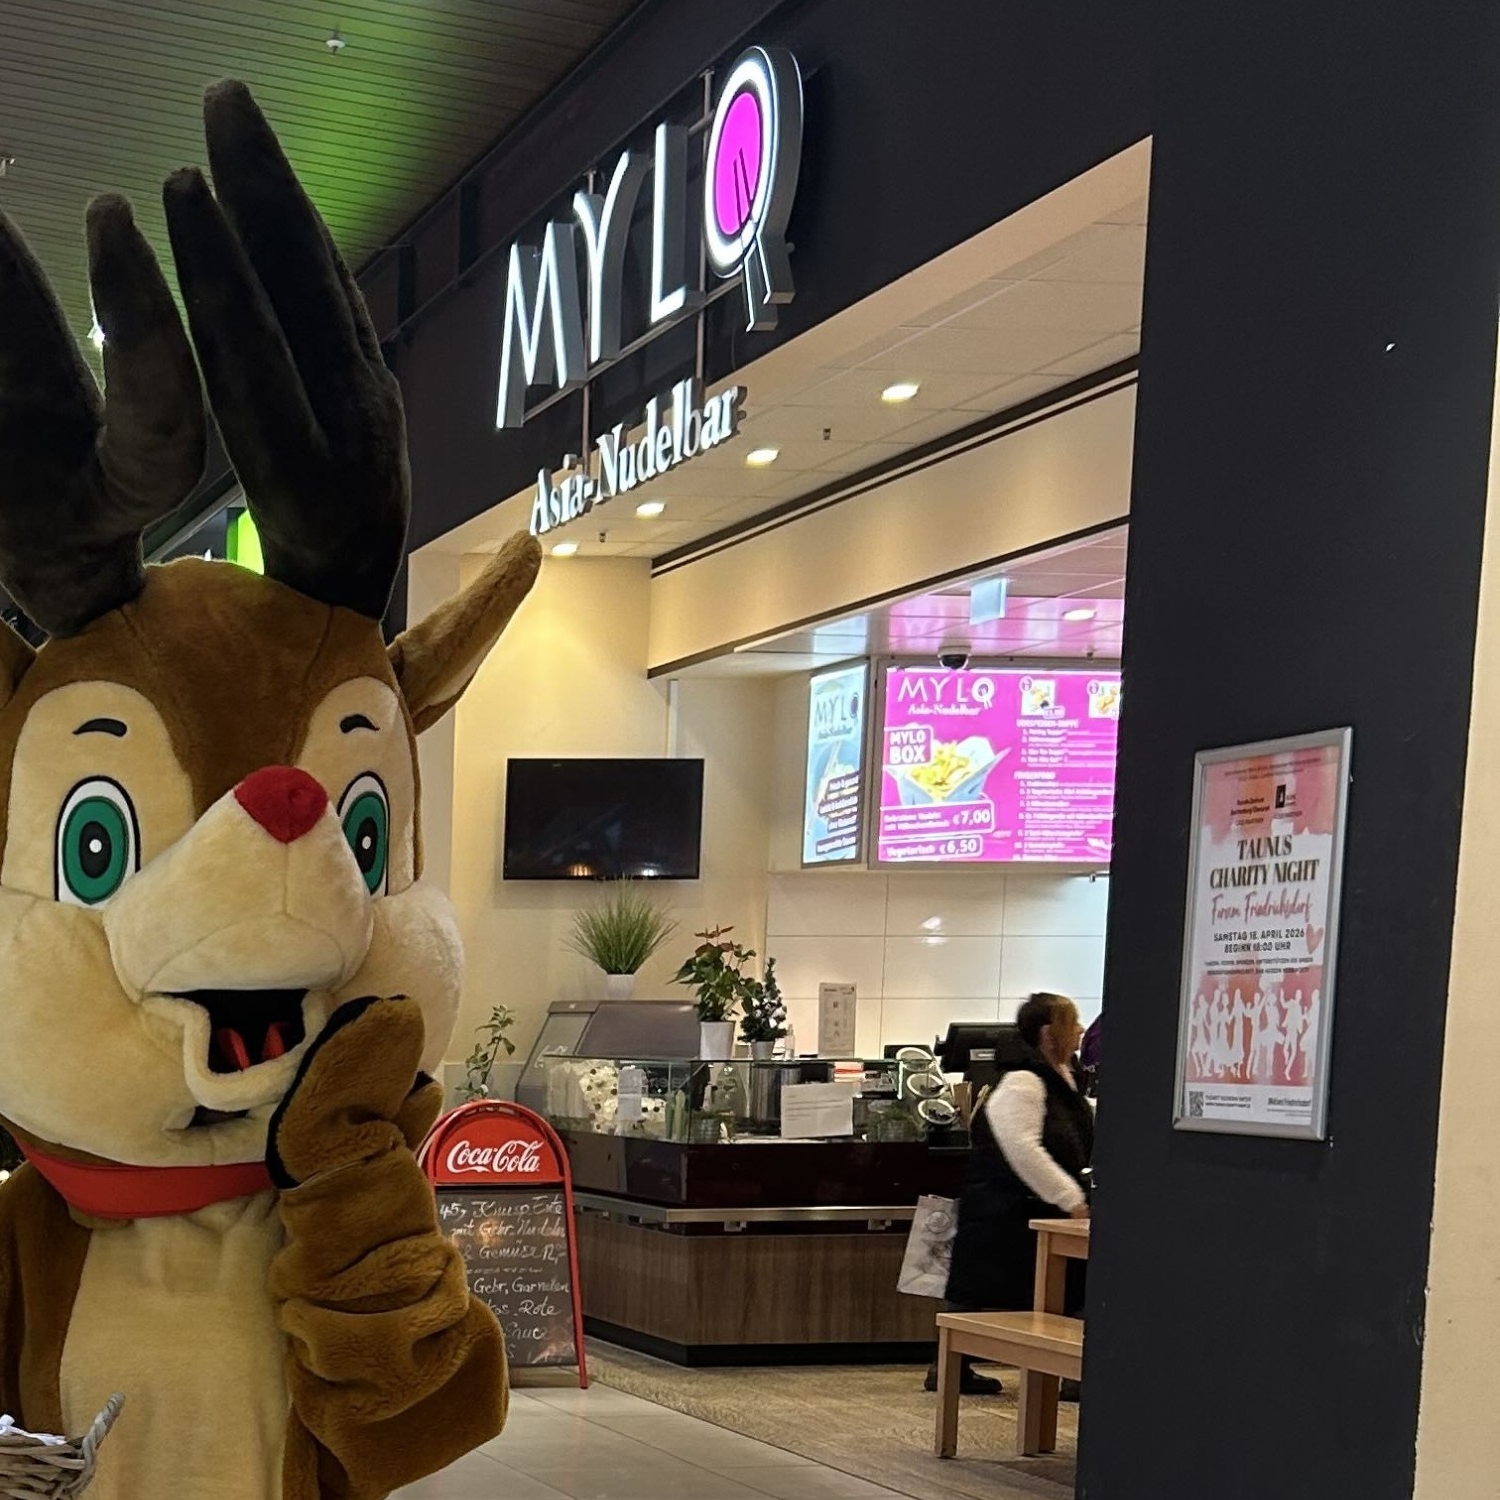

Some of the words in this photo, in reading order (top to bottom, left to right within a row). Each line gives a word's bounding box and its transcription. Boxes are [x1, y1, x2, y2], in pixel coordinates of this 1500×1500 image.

[496, 46, 786, 429] MYLO
[529, 378, 740, 535] Asia-Nudelbar
[890, 730, 926, 745] MYLO
[889, 745, 926, 764] BOX
[1238, 835, 1293, 860] TAUNUS
[1210, 864, 1269, 889] CHARITY
[1274, 859, 1320, 883] NIGHT
[1213, 931, 1248, 942] SAMSTAG
[1261, 929, 1283, 939] APRIL
[446, 1139, 544, 1174] Coca-Cola
